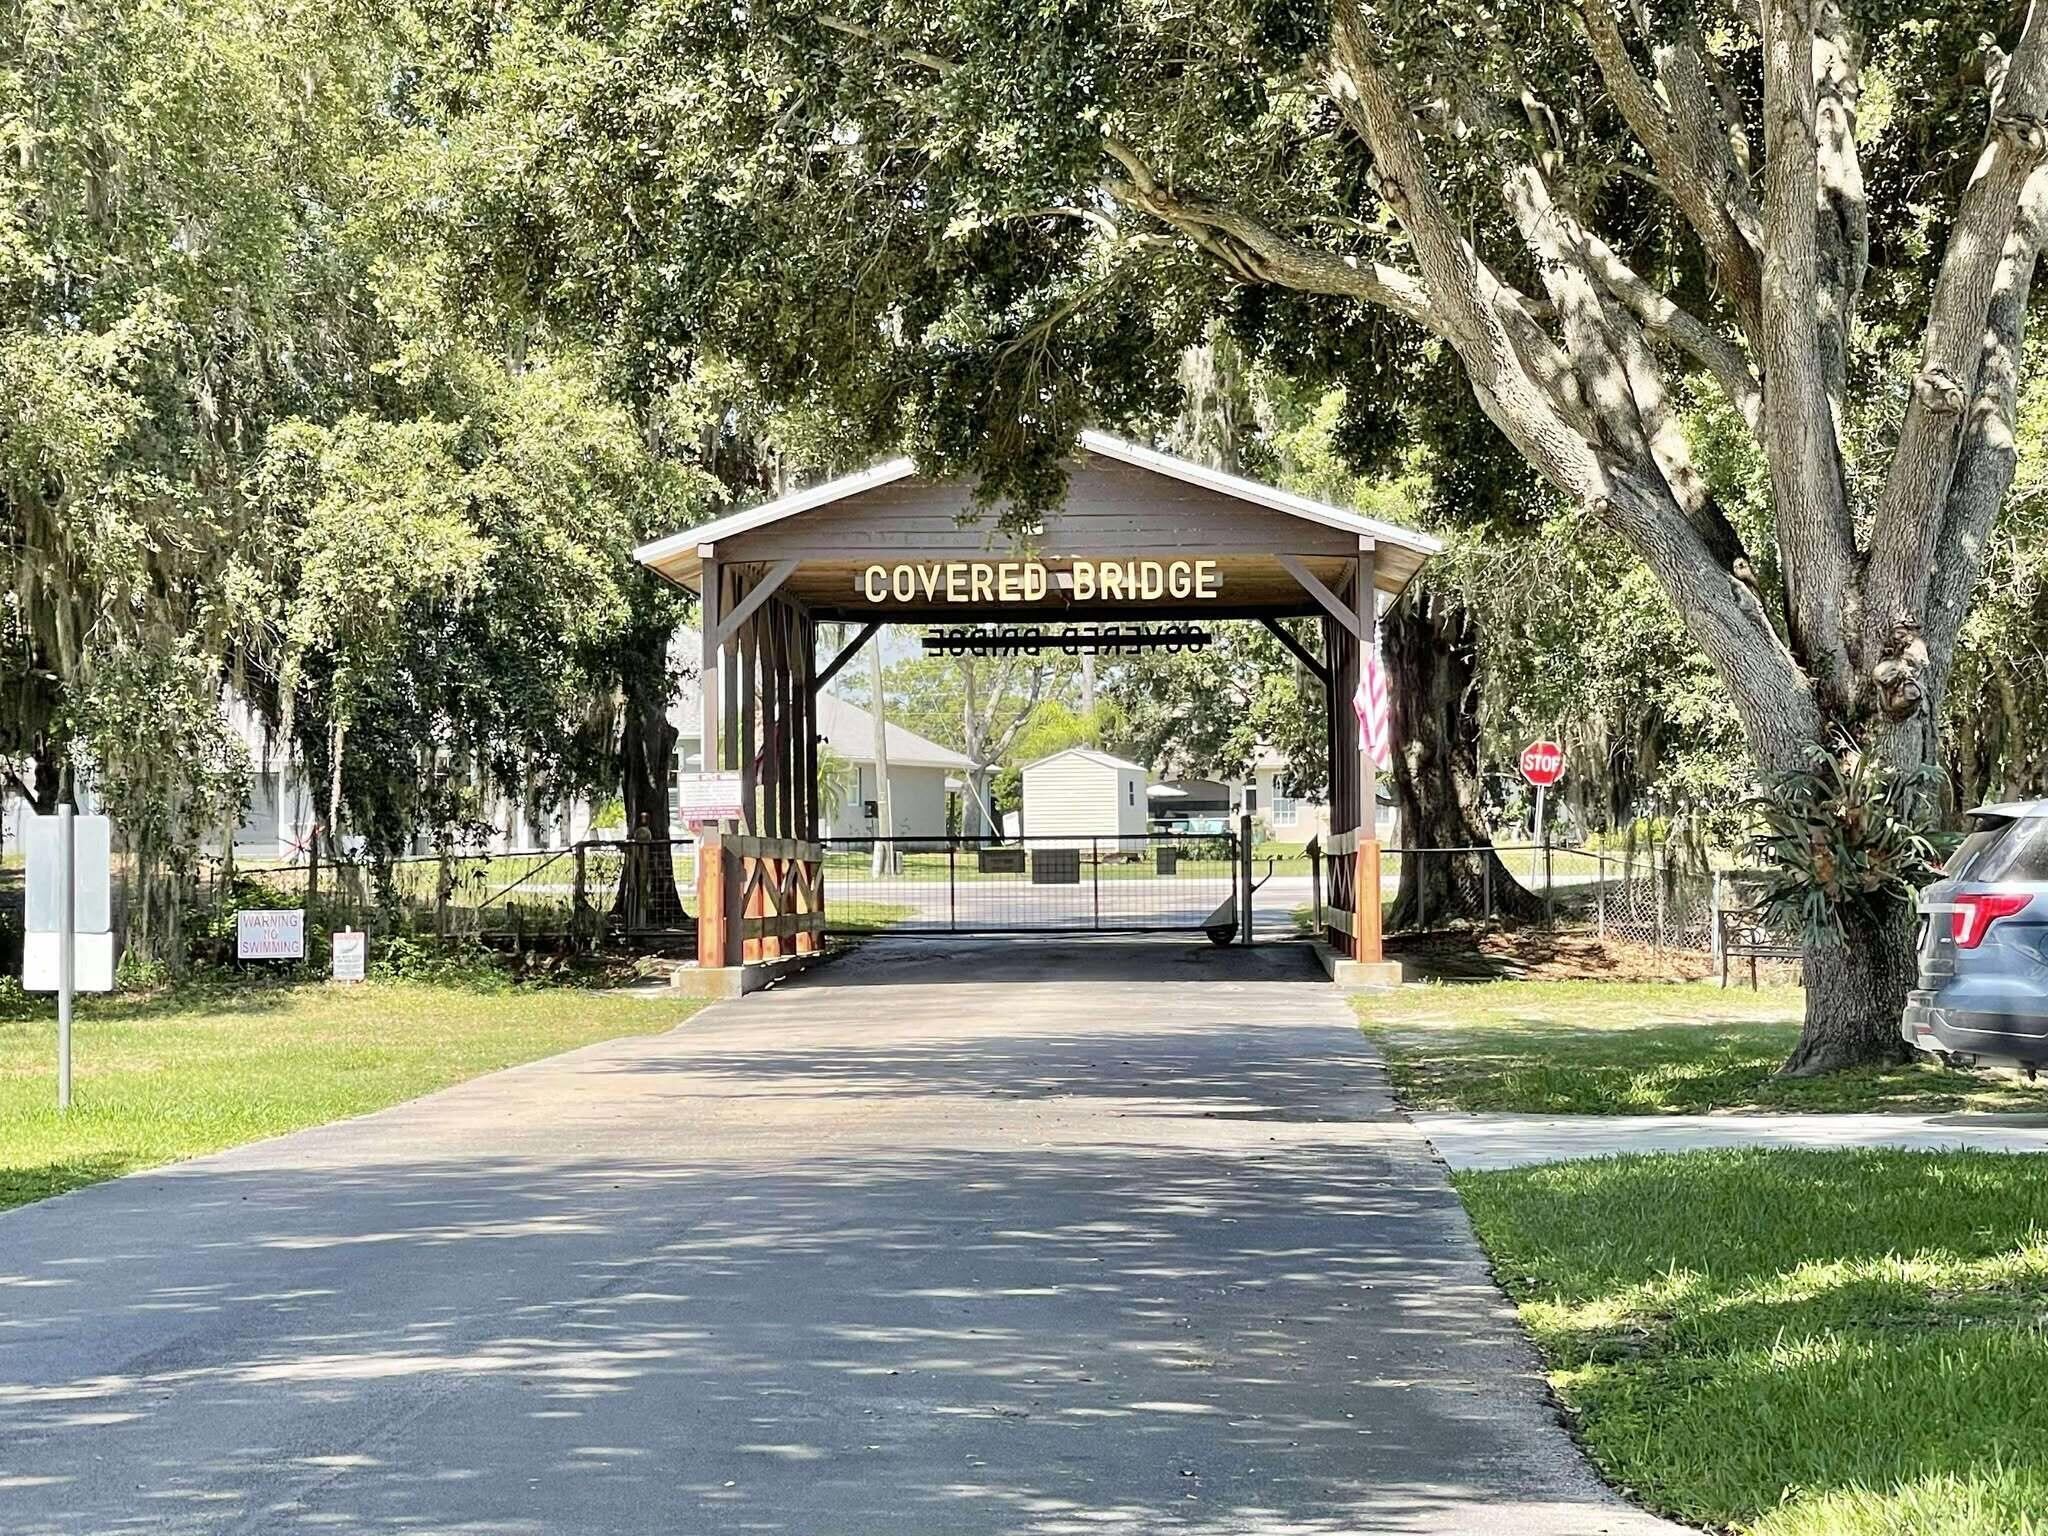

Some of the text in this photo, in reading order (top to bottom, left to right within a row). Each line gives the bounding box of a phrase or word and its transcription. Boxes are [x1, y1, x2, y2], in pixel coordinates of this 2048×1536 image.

[865, 560, 1218, 602] COVERED BRIDGE
[1524, 754, 1560, 772] STOP
[243, 915, 298, 928] WARNING
[242, 941, 300, 953] SWIMMING
